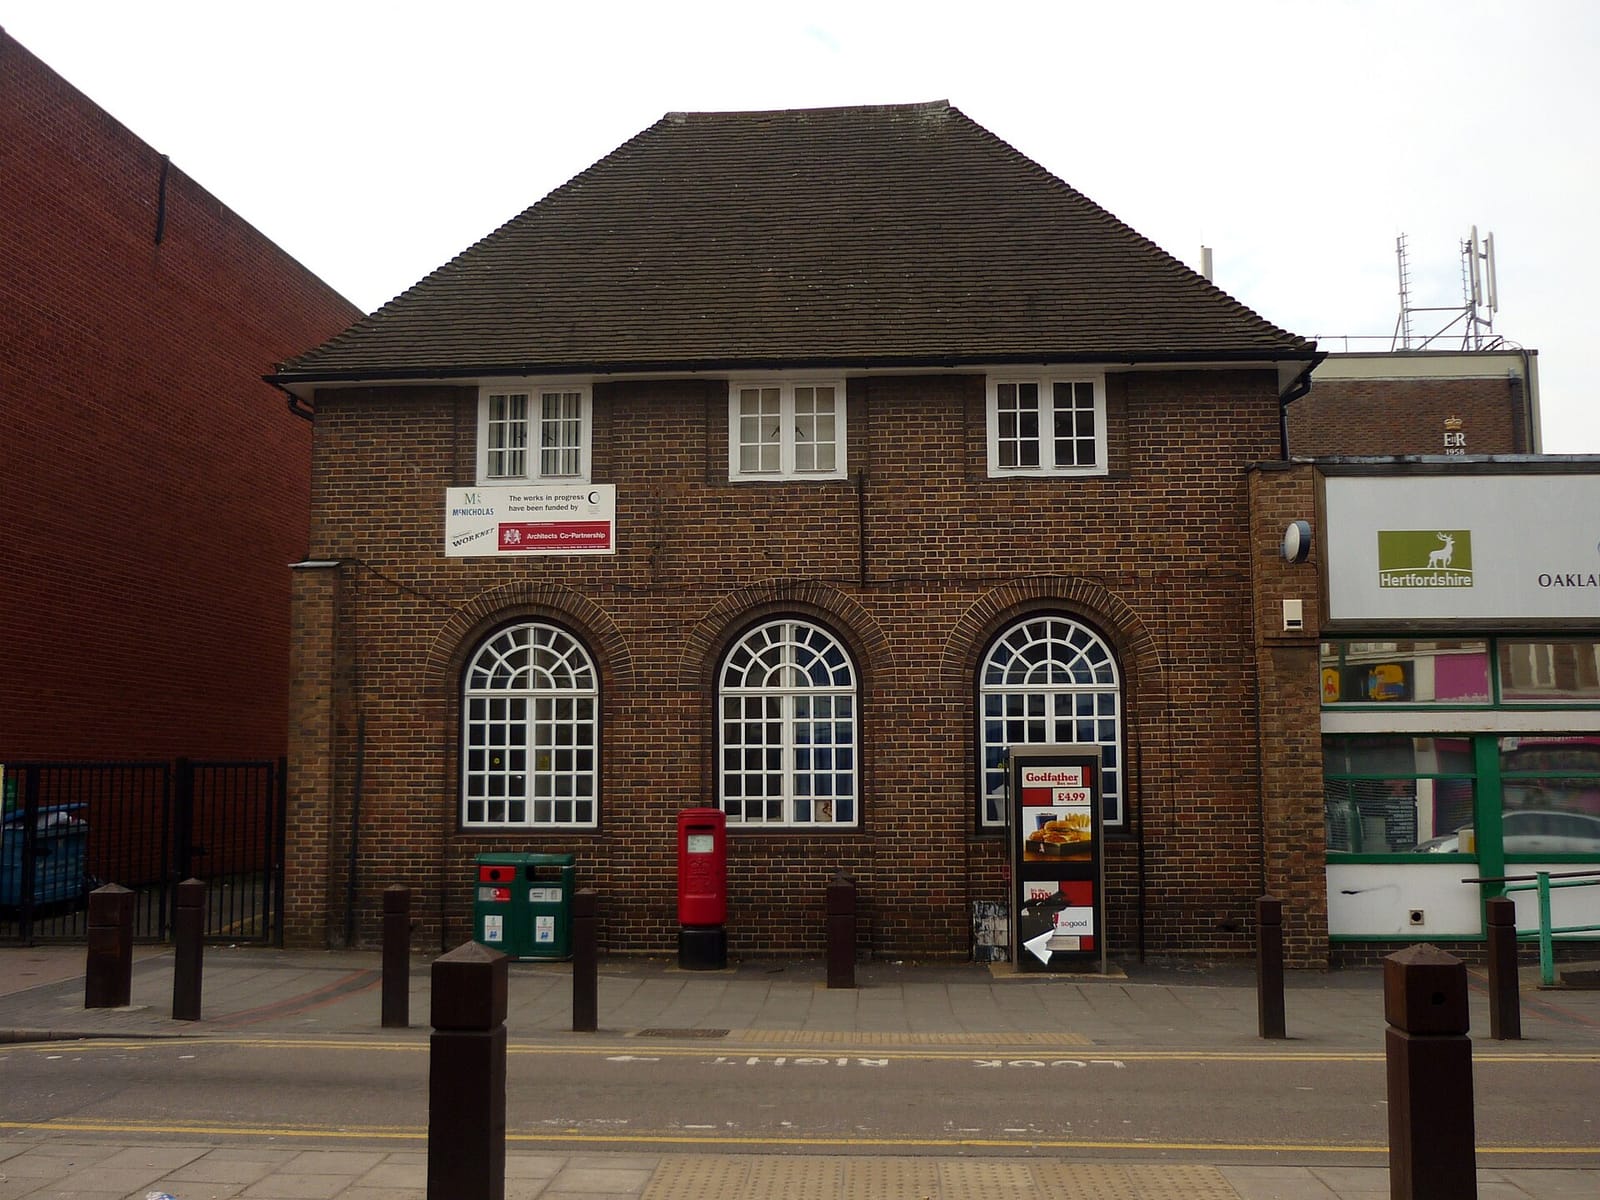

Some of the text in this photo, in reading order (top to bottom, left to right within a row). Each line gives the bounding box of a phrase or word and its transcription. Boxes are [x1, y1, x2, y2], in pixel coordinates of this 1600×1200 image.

[554, 494, 585, 503] progress
[545, 503, 569, 511] funded
[570, 503, 579, 511] by
[526, 531, 606, 540] Architects Co-Partnership
[1380, 572, 1472, 588] Hertfordshire
[1538, 573, 1600, 587] OAKLA
[1026, 772, 1078, 781] Godfather
[1057, 792, 1085, 801] £4.99
[972, 1058, 1126, 1069] LOOK
